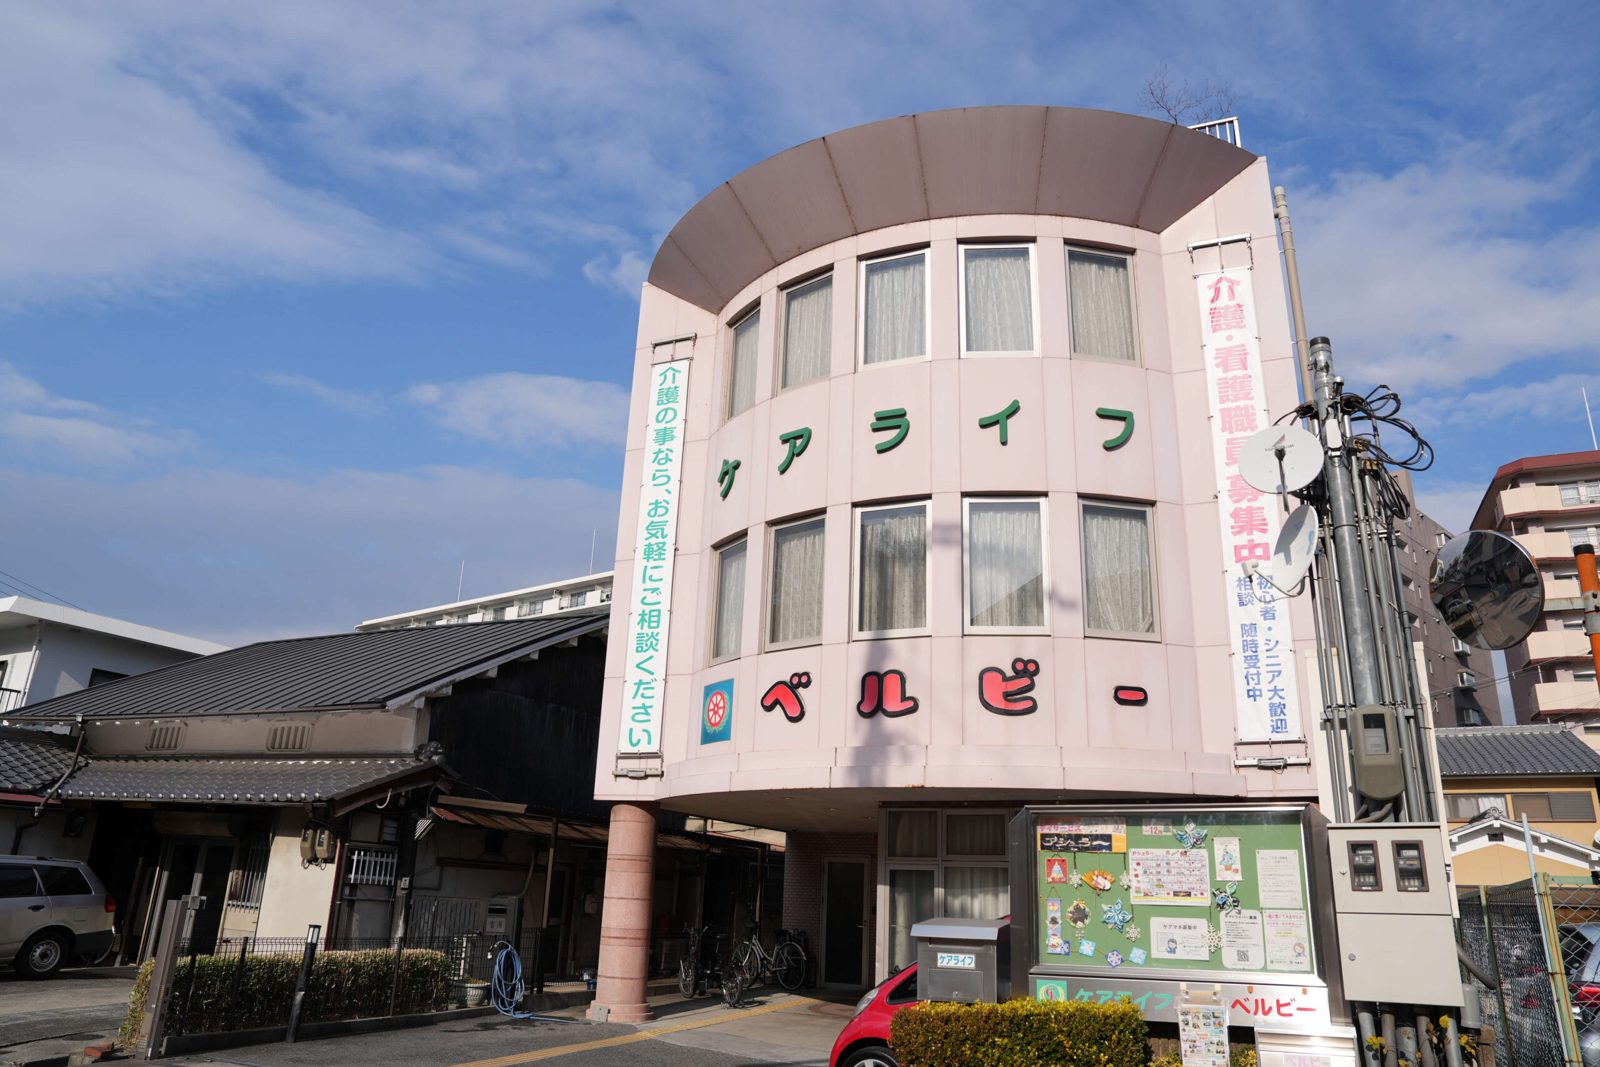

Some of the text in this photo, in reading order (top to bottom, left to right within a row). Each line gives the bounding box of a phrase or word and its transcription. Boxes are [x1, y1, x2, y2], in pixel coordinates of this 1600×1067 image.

[717, 399, 1135, 501] ケアライフ
[628, 366, 681, 748] 介護の事なら、お気軽にご相談ください
[760, 657, 1148, 723] ベルビー
[1241, 623, 1263, 702] 随時受付中
[1256, 575, 1288, 734] 初心者・シニア大歓迎
[939, 954, 974, 966] ケアライフ
[1231, 997, 1317, 1017] ベルビー
